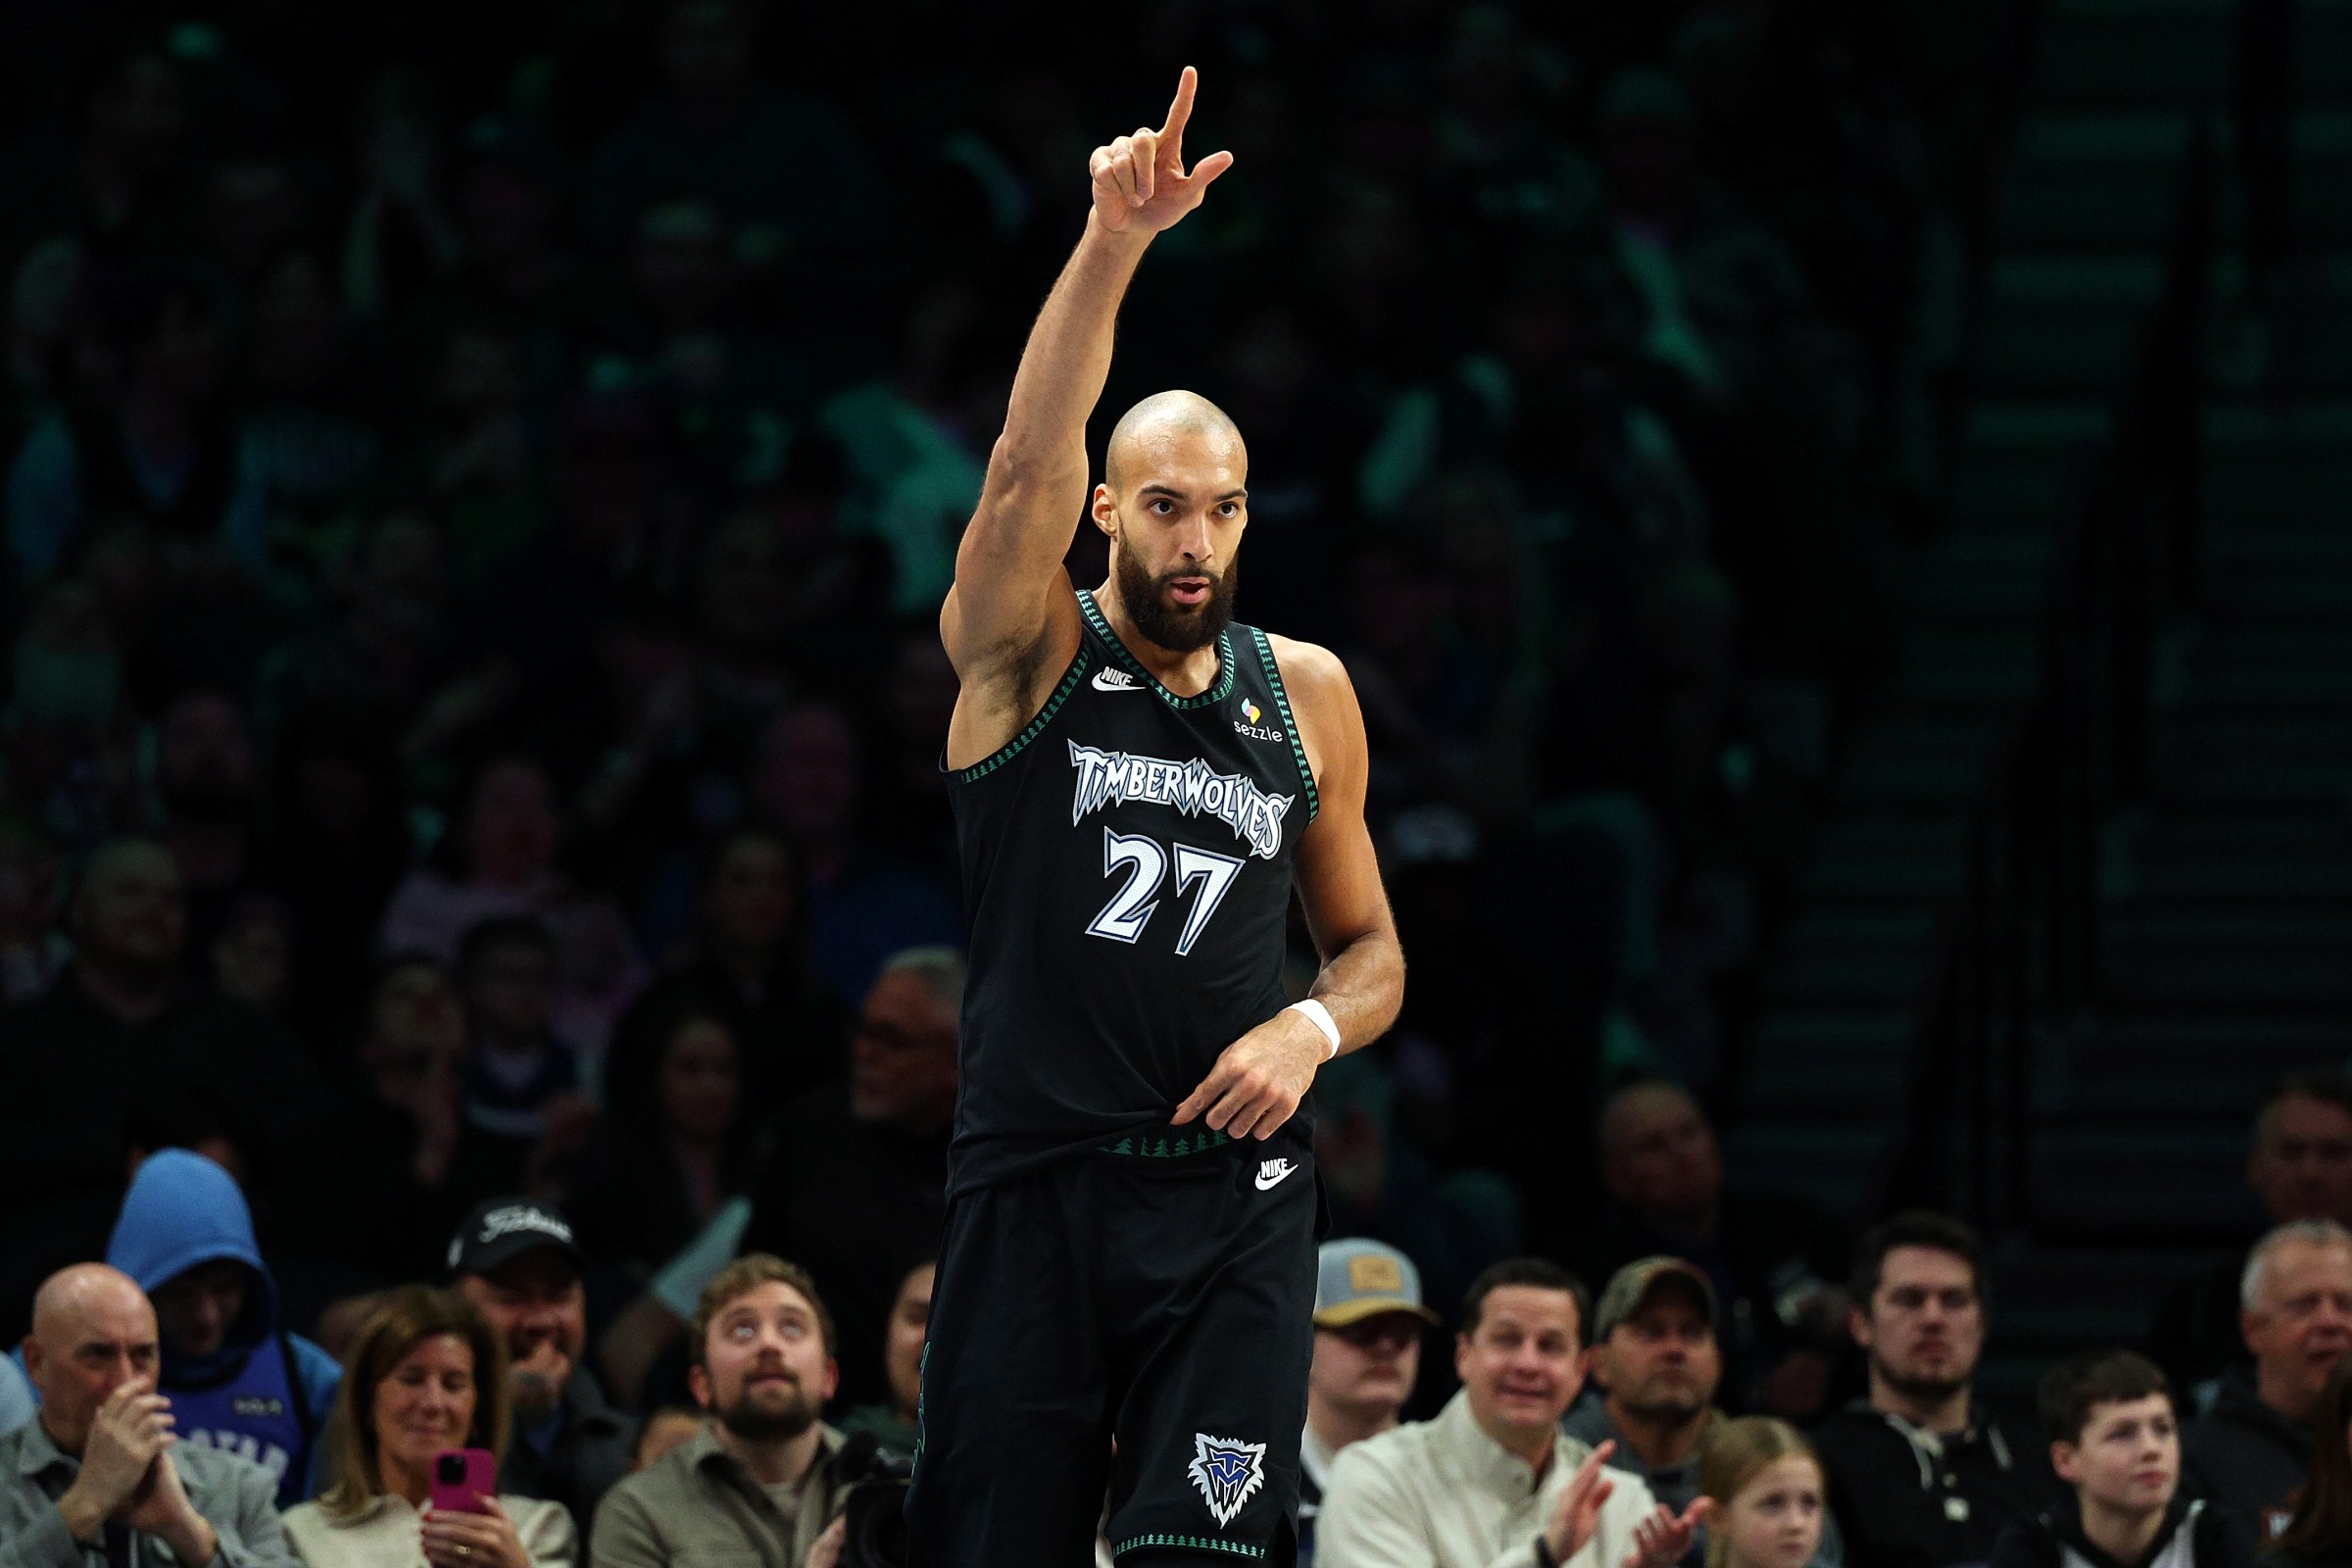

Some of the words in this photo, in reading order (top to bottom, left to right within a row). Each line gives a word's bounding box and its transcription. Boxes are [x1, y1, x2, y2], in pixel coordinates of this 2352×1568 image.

[1101, 666, 1134, 686] NIKE
[1234, 720, 1283, 743] sezzle
[1067, 738, 1296, 859] TIMBERWOLVES
[1085, 825, 1247, 956] 27
[1260, 1157, 1288, 1178] NIKE
